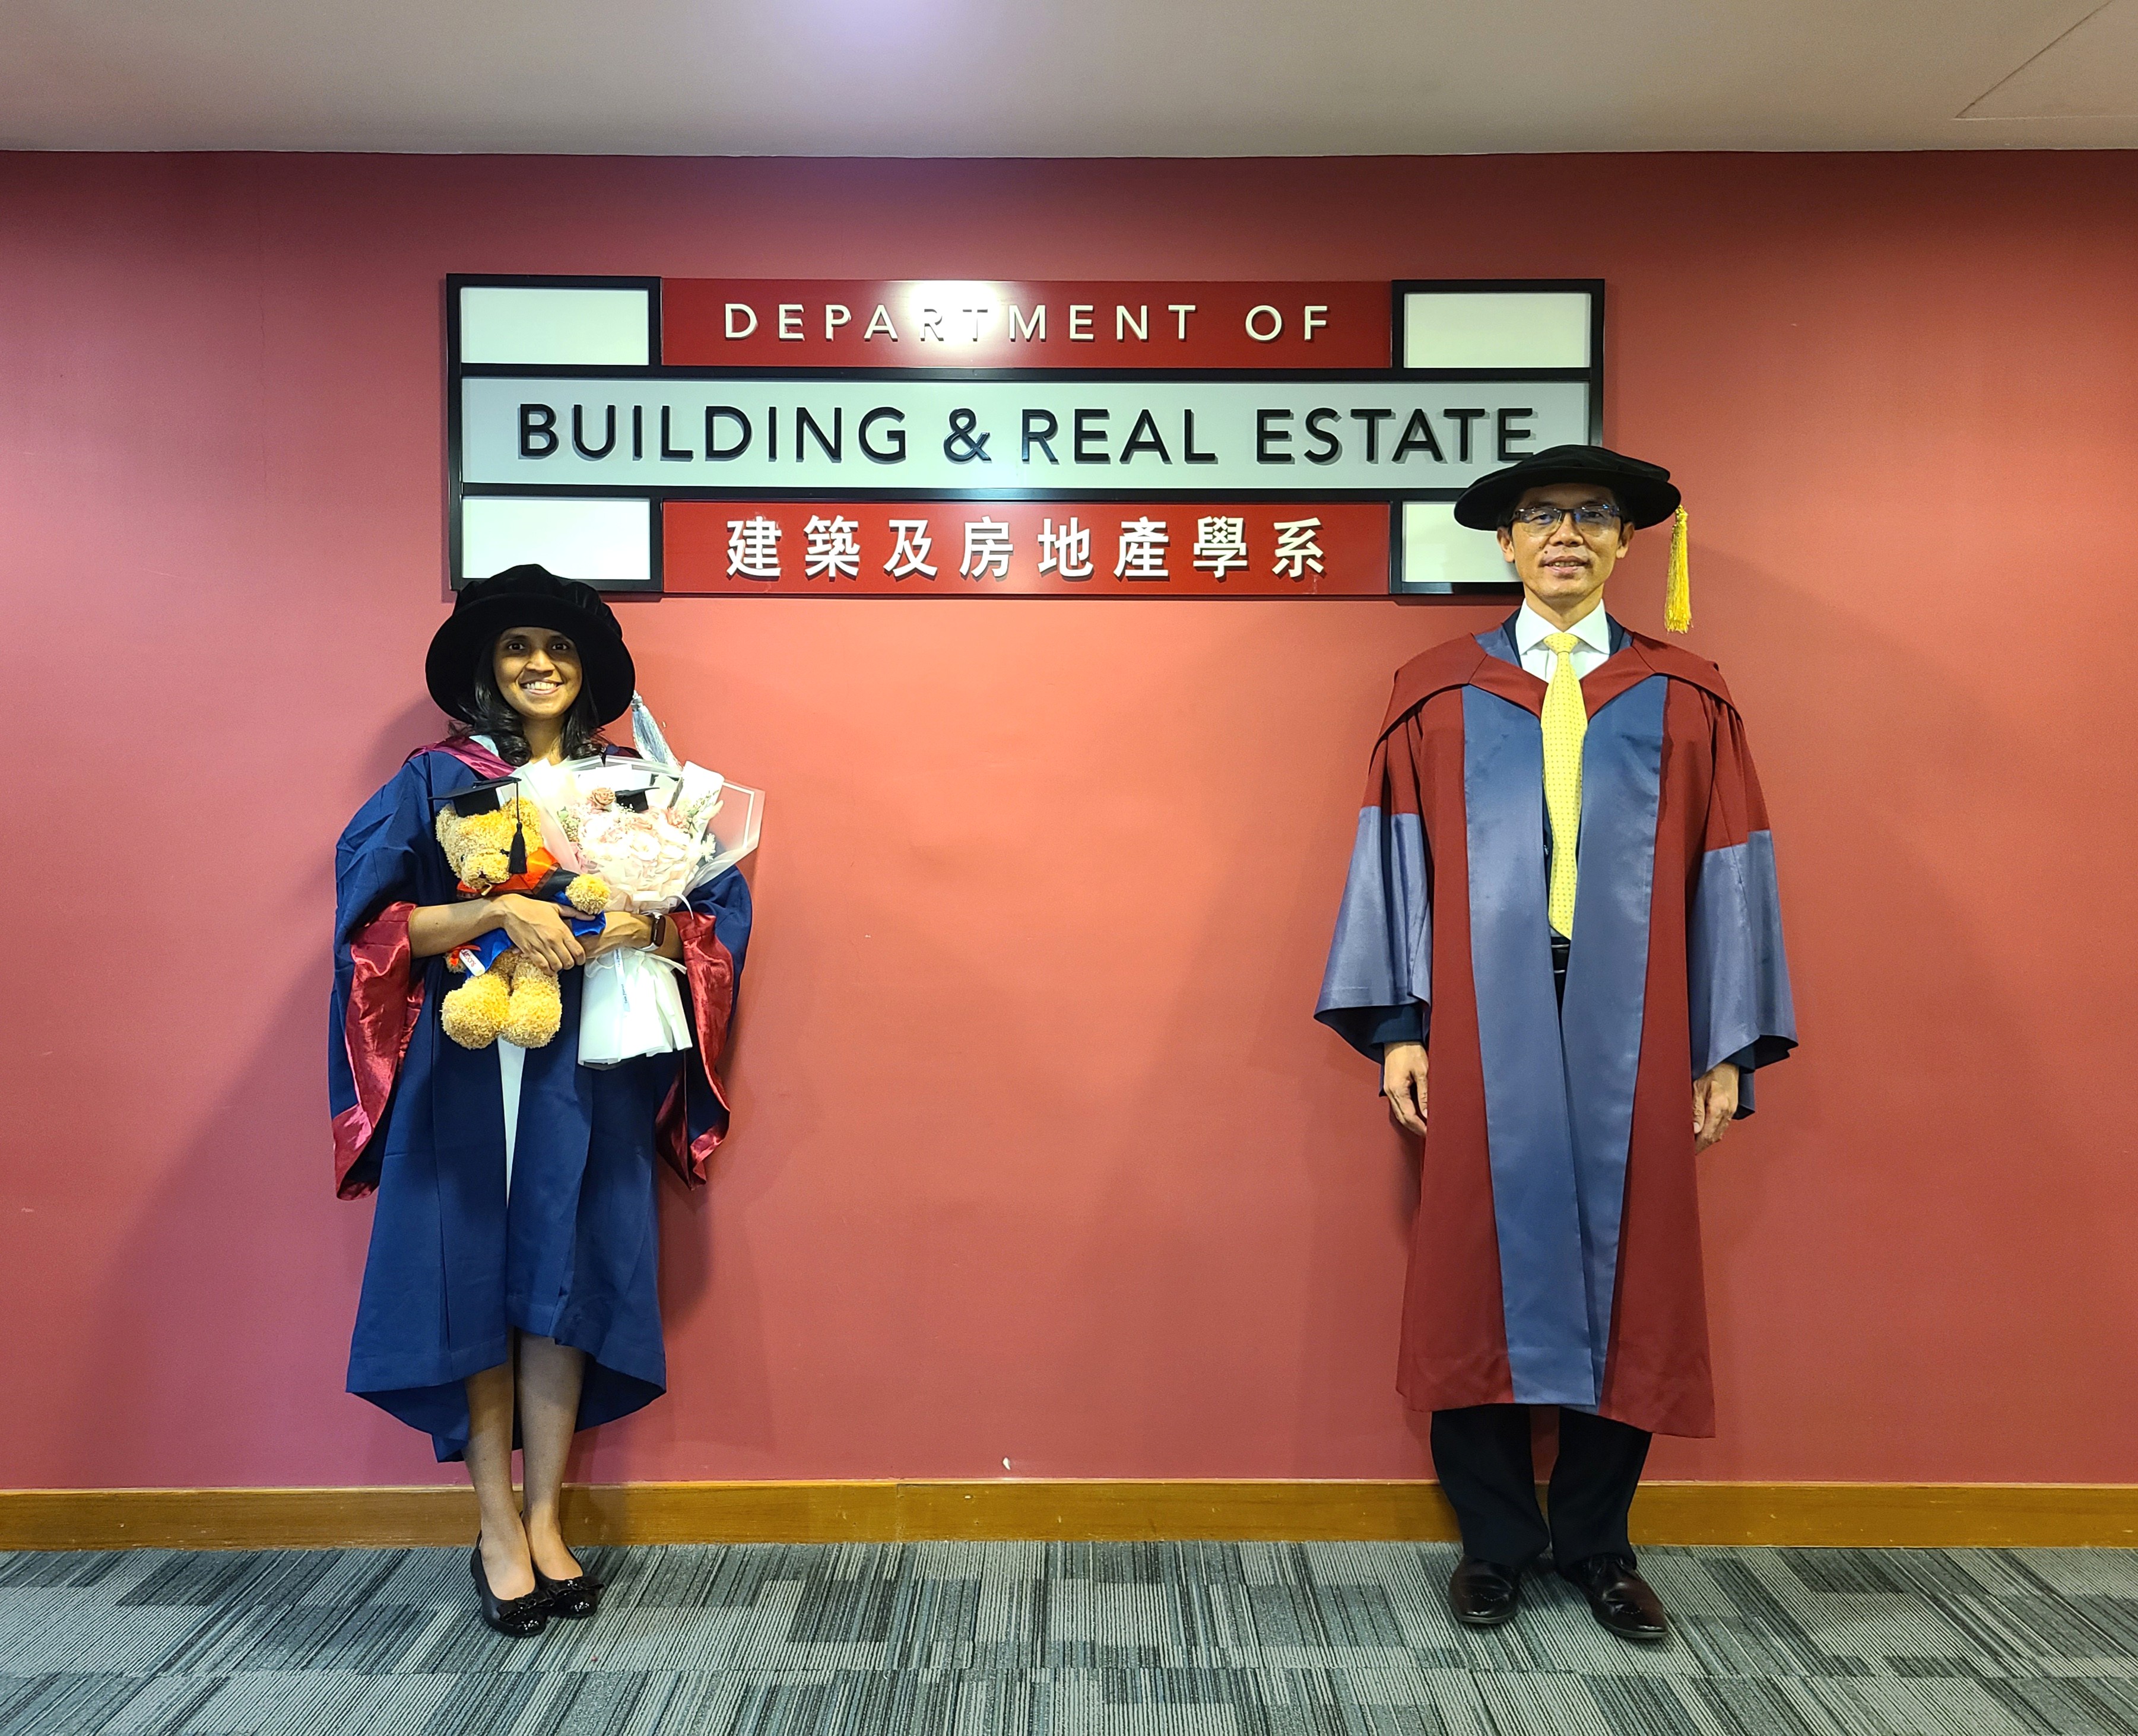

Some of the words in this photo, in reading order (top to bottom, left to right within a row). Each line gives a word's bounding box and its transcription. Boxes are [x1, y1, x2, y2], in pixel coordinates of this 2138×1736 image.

[724, 303, 1196, 341] DEPARTMENT
[1245, 304, 1330, 342] OF
[519, 403, 907, 462] BUILDING
[942, 407, 992, 462] &
[1021, 408, 1216, 464] REAL
[1255, 407, 1533, 464] ESTATE
[727, 515, 1324, 579] 建築及房地產學系
